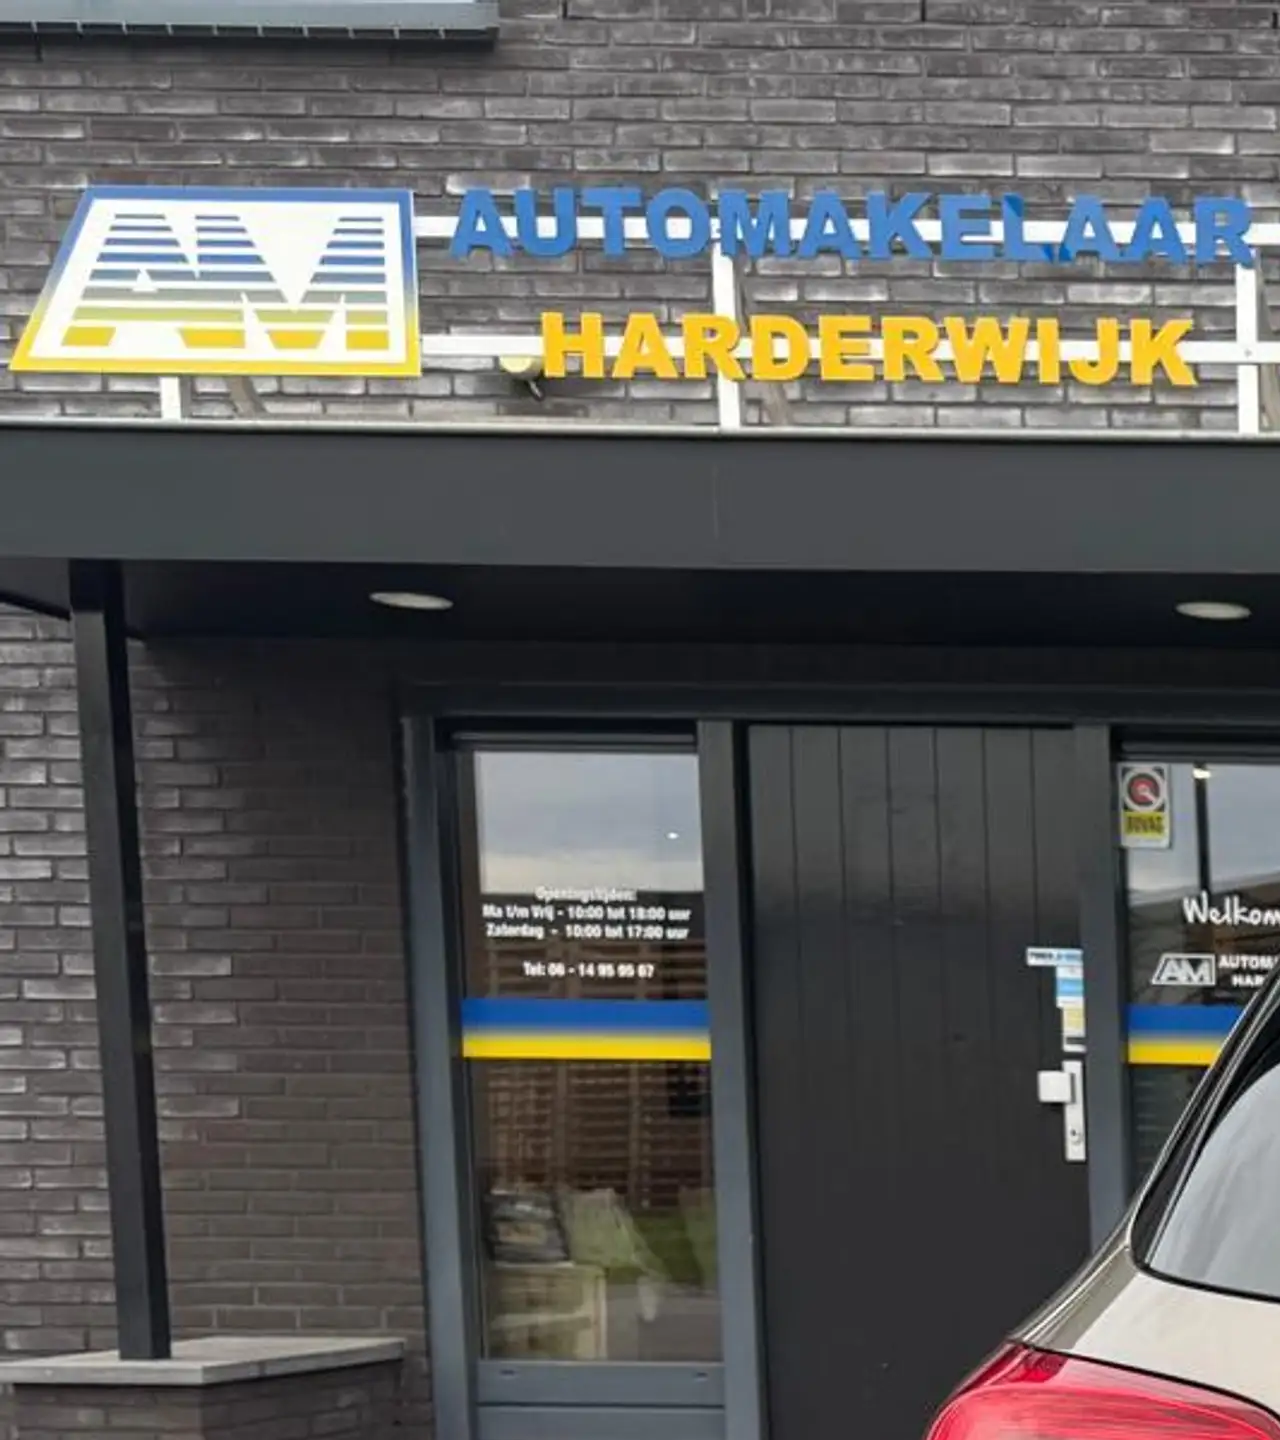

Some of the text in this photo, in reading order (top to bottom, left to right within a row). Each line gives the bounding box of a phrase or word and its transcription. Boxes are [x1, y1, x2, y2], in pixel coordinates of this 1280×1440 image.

[450, 186, 1255, 270] AUTOMAKELAAR
[61, 213, 390, 350] AM
[541, 311, 1198, 388] HARDERWIJK
[486, 923, 544, 939] Zaterdag
[565, 924, 602, 938] 10:00
[567, 905, 604, 919] 10:00
